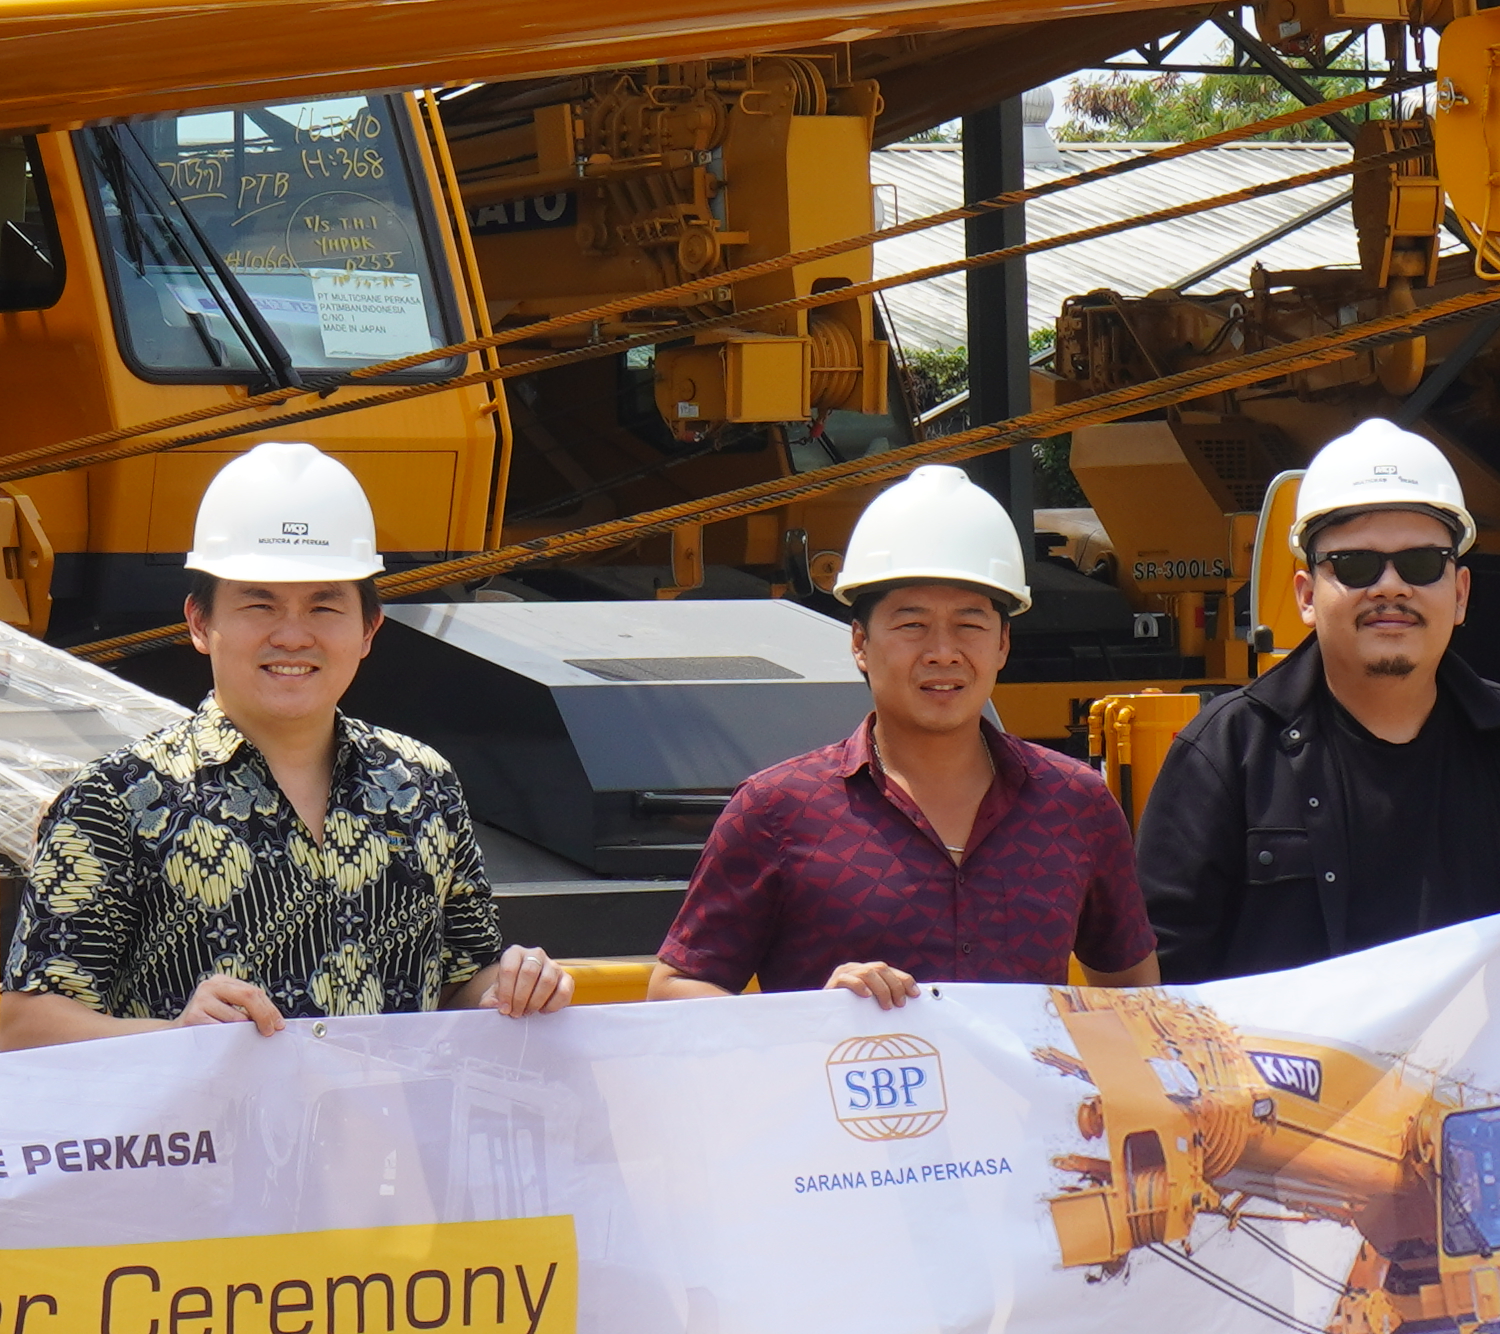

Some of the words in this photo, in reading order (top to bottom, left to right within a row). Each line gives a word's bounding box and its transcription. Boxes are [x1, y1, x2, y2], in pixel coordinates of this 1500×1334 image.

[237, 171, 290, 210] PTB
[331, 293, 382, 304] MULTICRANE
[384, 295, 421, 305] PERKASA
[323, 324, 349, 333] MADE
[350, 325, 358, 333] IN
[359, 325, 387, 334] JAPAN
[1134, 558, 1224, 581] SR-300LS
[844, 1066, 928, 1111] SBP
[1253, 1053, 1319, 1097] KATO
[22, 1129, 218, 1175] PERKASA
[794, 1171, 868, 1194] SARANA
[870, 1166, 919, 1188] BAJA
[921, 1156, 1013, 1183] PERKASA
